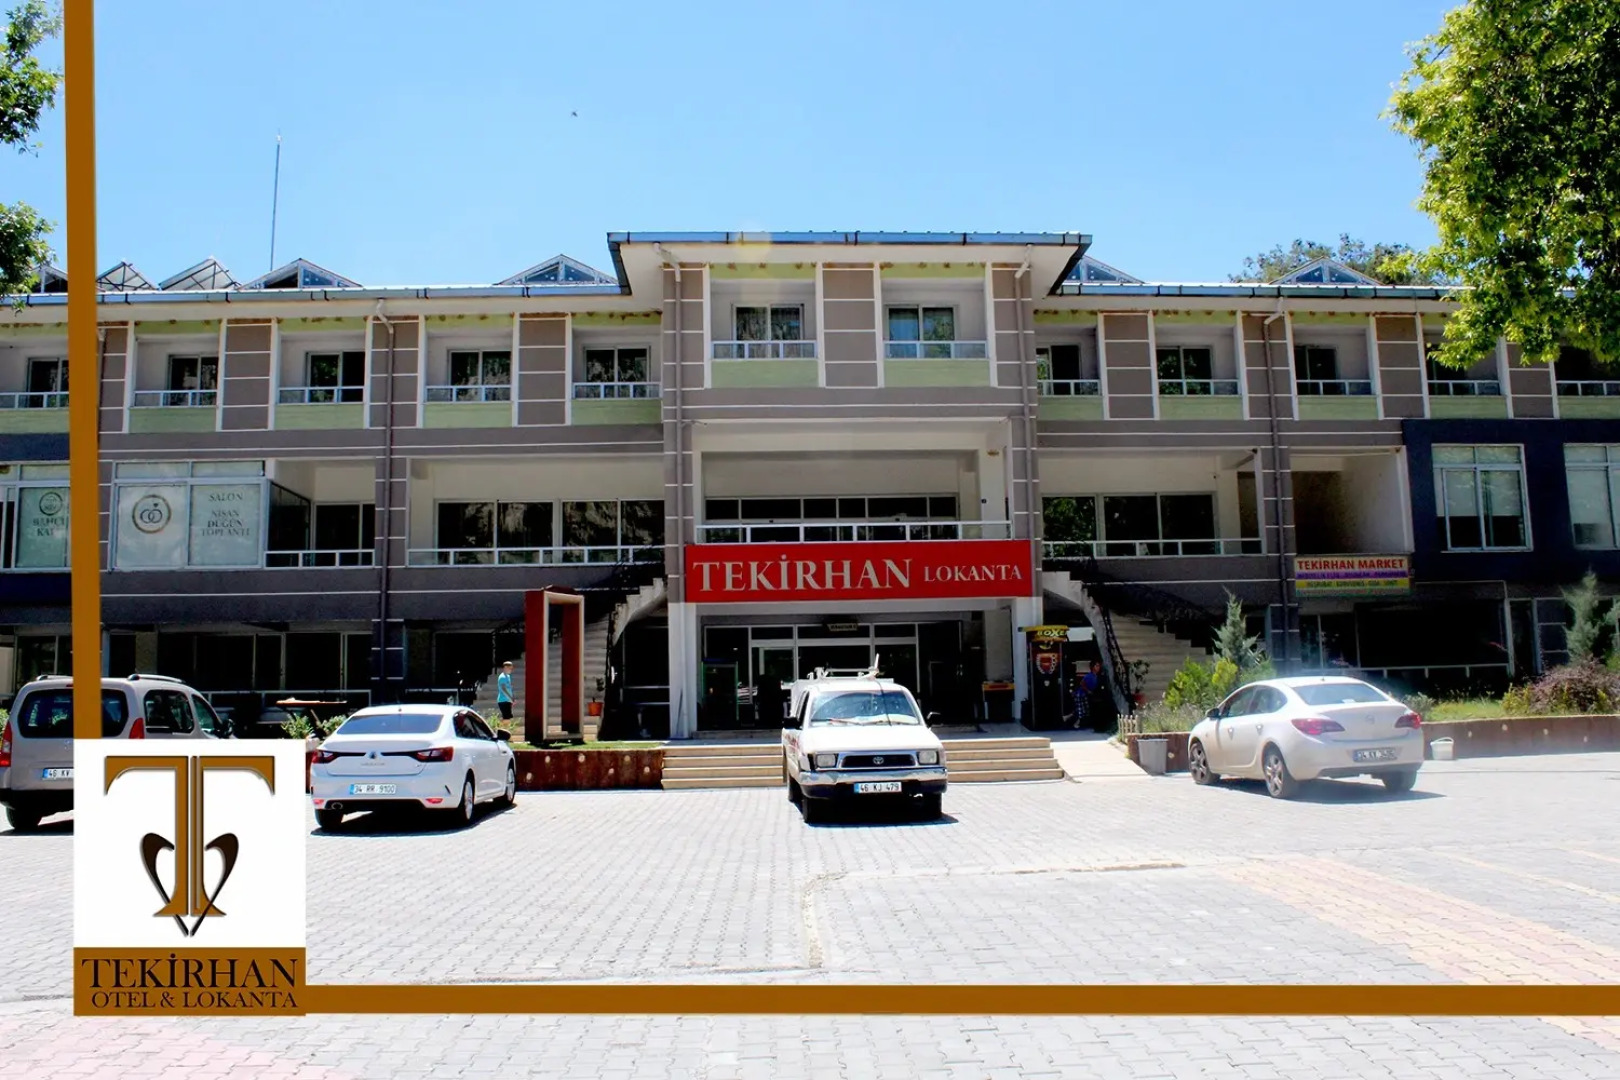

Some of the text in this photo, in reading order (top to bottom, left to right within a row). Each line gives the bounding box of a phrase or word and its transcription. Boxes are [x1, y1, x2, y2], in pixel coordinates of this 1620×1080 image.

[208, 492, 244, 502] SALON
[1358, 559, 1404, 569] MARKET
[692, 554, 1022, 592] TEKİRHAN LOKANTA
[860, 783, 869, 792] 46
